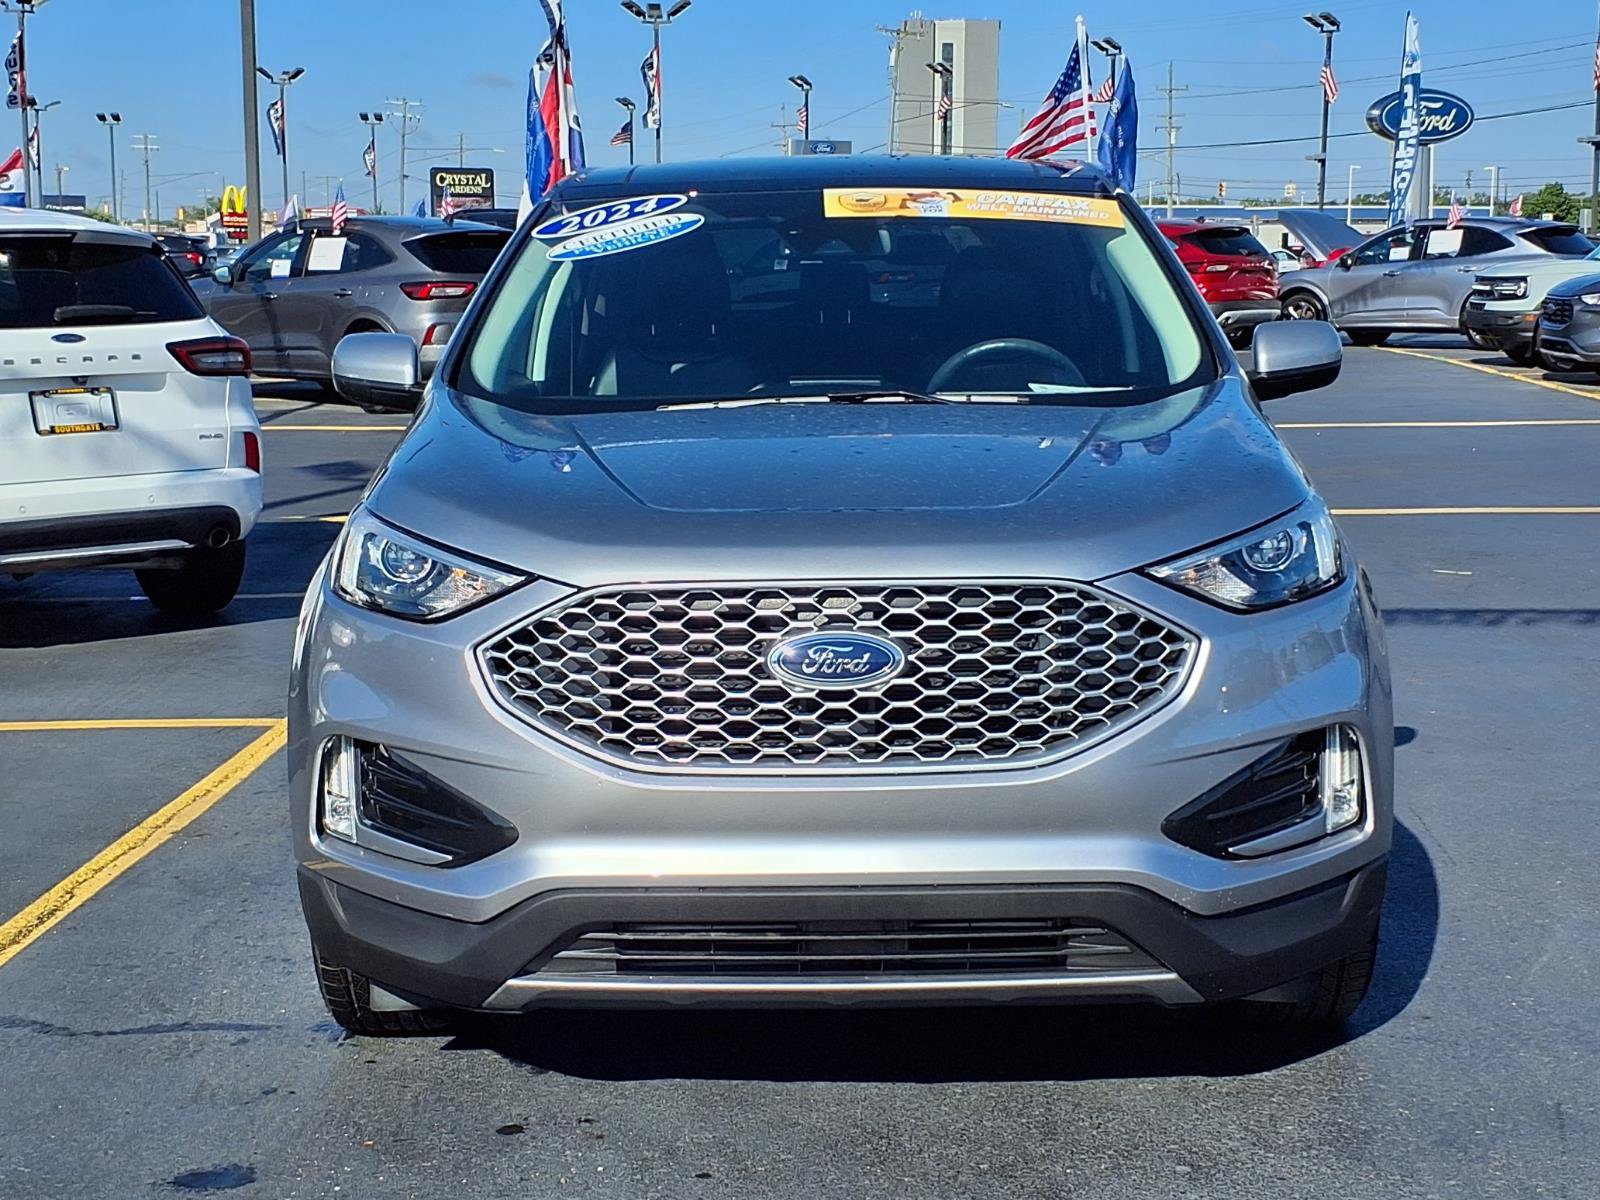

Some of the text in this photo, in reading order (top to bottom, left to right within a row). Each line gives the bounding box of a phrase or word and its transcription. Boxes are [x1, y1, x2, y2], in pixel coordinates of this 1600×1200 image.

[435, 172, 491, 188] CRYSTAL
[976, 193, 1091, 210] CARFAX
[557, 197, 659, 234] 2024
[966, 202, 1009, 212] WELL
[1012, 204, 1110, 220] MAINTAINED
[562, 215, 682, 251] CERTIFIED
[54, 423, 101, 434] SOUTHGATE
[801, 645, 871, 674] Ford
